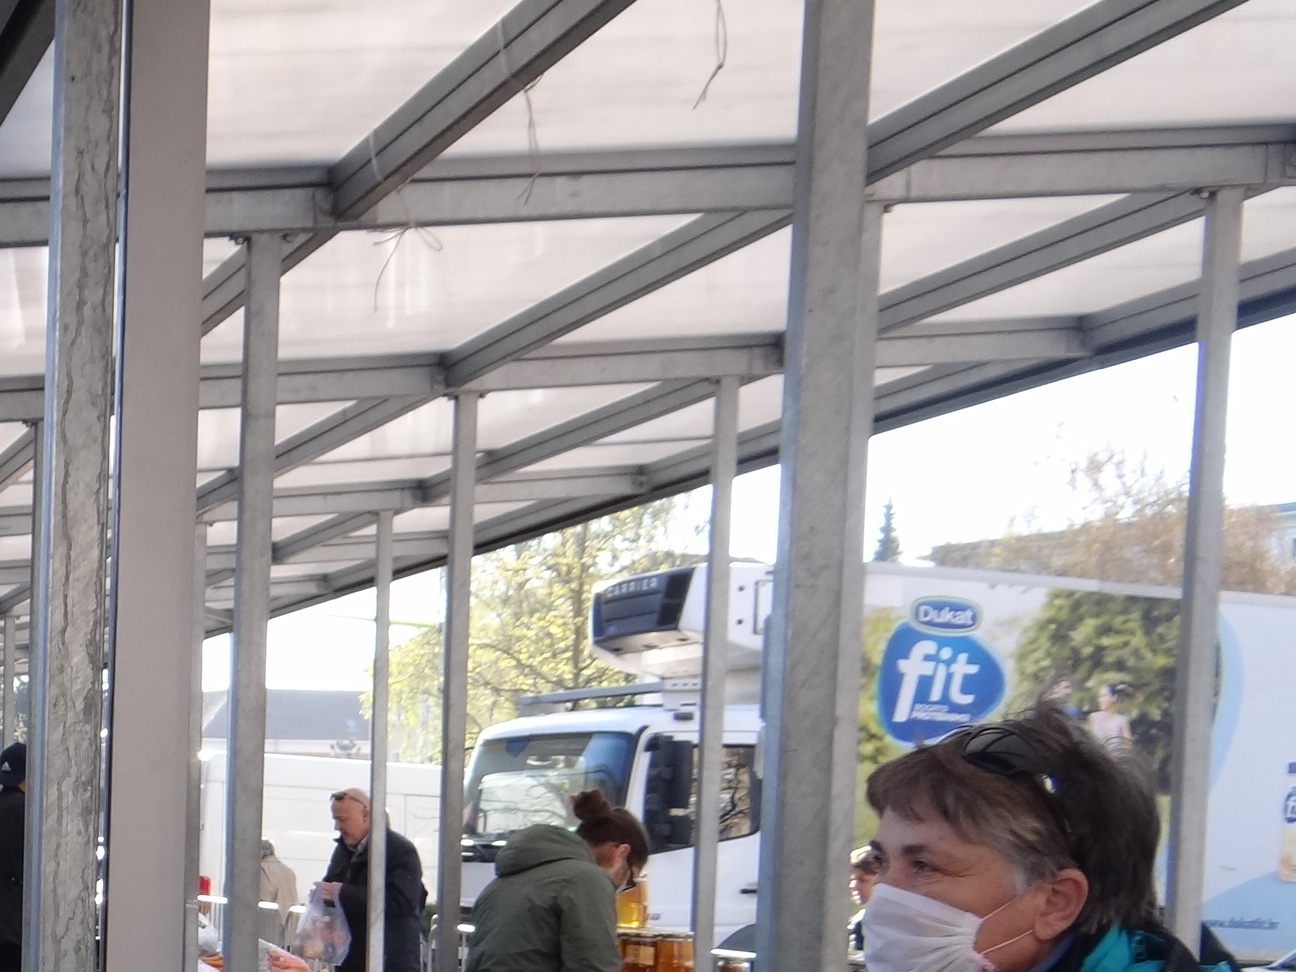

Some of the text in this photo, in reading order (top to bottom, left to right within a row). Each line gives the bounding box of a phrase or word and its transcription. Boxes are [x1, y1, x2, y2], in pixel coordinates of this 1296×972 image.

[605, 577, 659, 598] CARRIER
[917, 605, 974, 625] Dukat
[891, 640, 980, 722] fit
